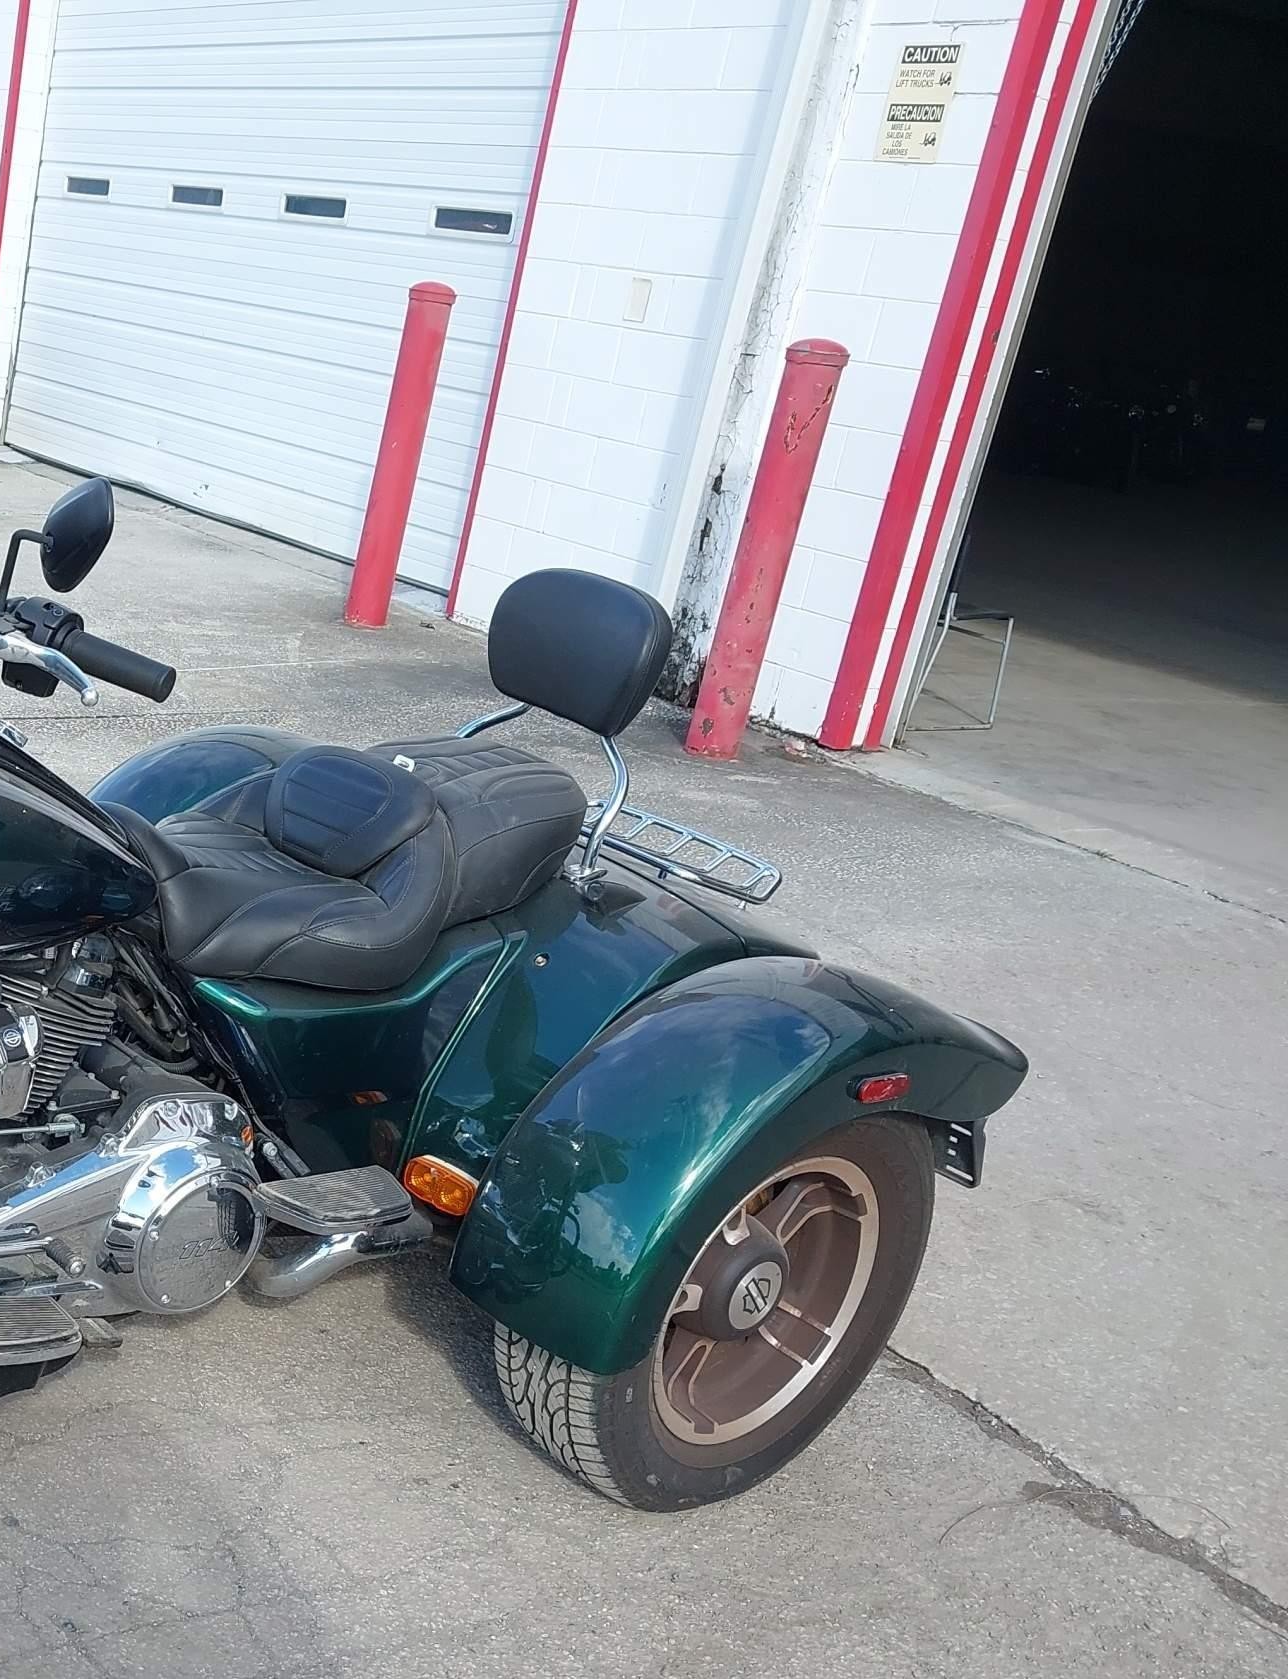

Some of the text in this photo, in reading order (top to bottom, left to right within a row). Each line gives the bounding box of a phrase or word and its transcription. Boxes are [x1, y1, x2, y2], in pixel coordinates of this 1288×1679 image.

[904, 46, 959, 62] CAUTION
[900, 69, 936, 78] WATCH FOR
[896, 79, 934, 88] LIFT TRUCKS
[888, 105, 944, 121] PRECAUCION
